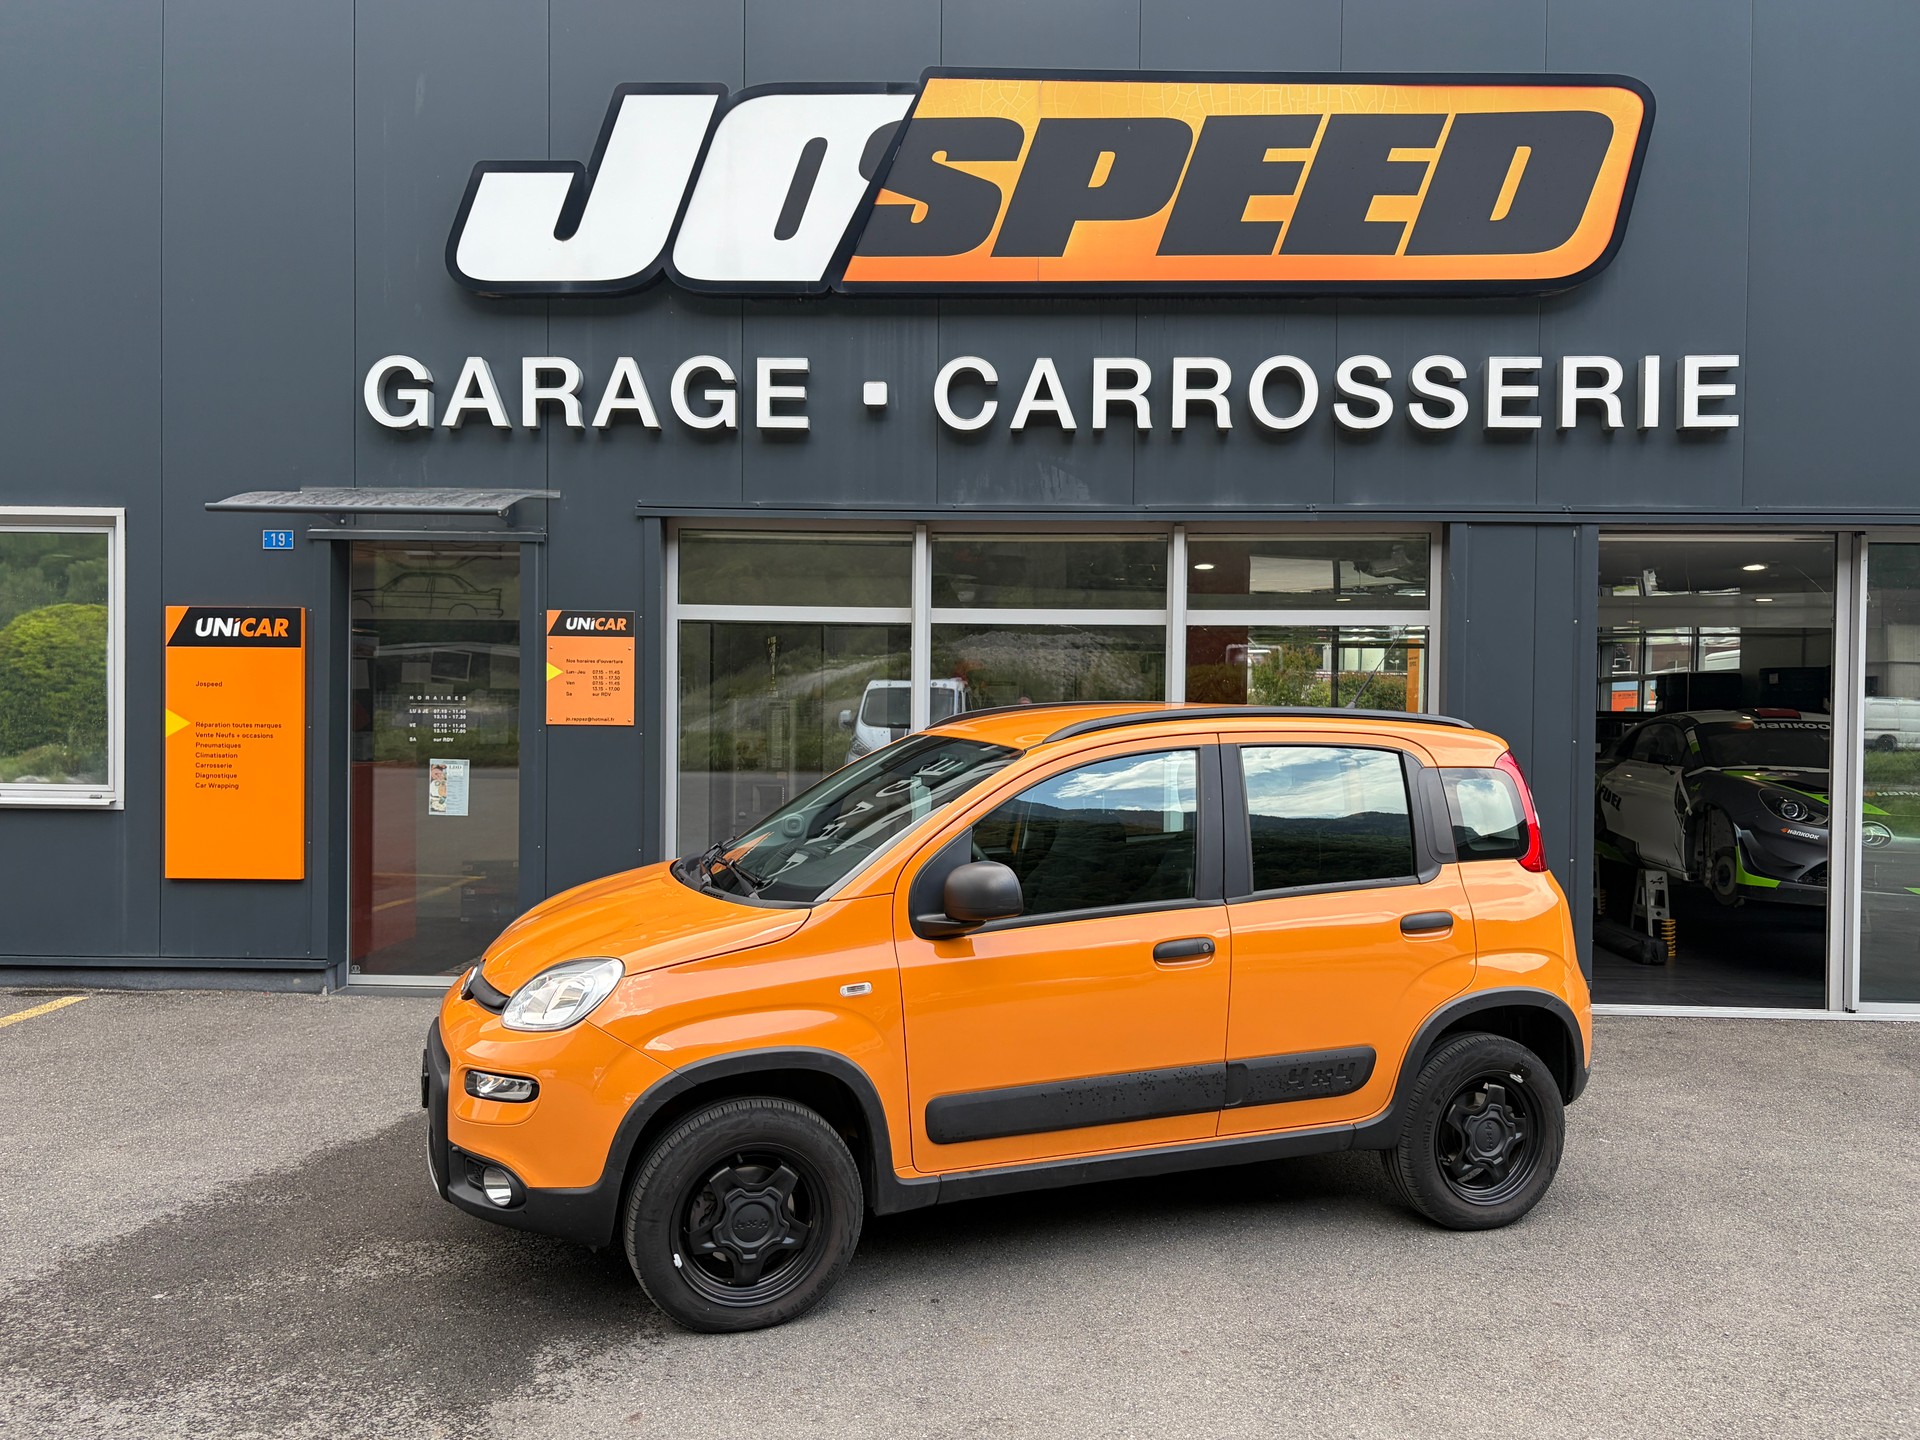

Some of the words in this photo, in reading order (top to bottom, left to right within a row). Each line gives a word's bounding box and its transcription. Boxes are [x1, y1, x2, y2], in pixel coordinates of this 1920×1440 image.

[363, 354, 812, 432] GARAGE
[933, 354, 1741, 433] CARROSSERIE
[270, 532, 286, 547] 19
[195, 680, 223, 689] Jospeed
[195, 721, 231, 730] Réparation
[254, 722, 282, 730] marques
[195, 741, 242, 750] Pneumatiques
[195, 751, 238, 759] Climatisation
[195, 761, 233, 769] Carrosserie
[195, 771, 238, 780] Diagnostique
[194, 781, 207, 789] Car
[208, 782, 240, 791] Wrapping
